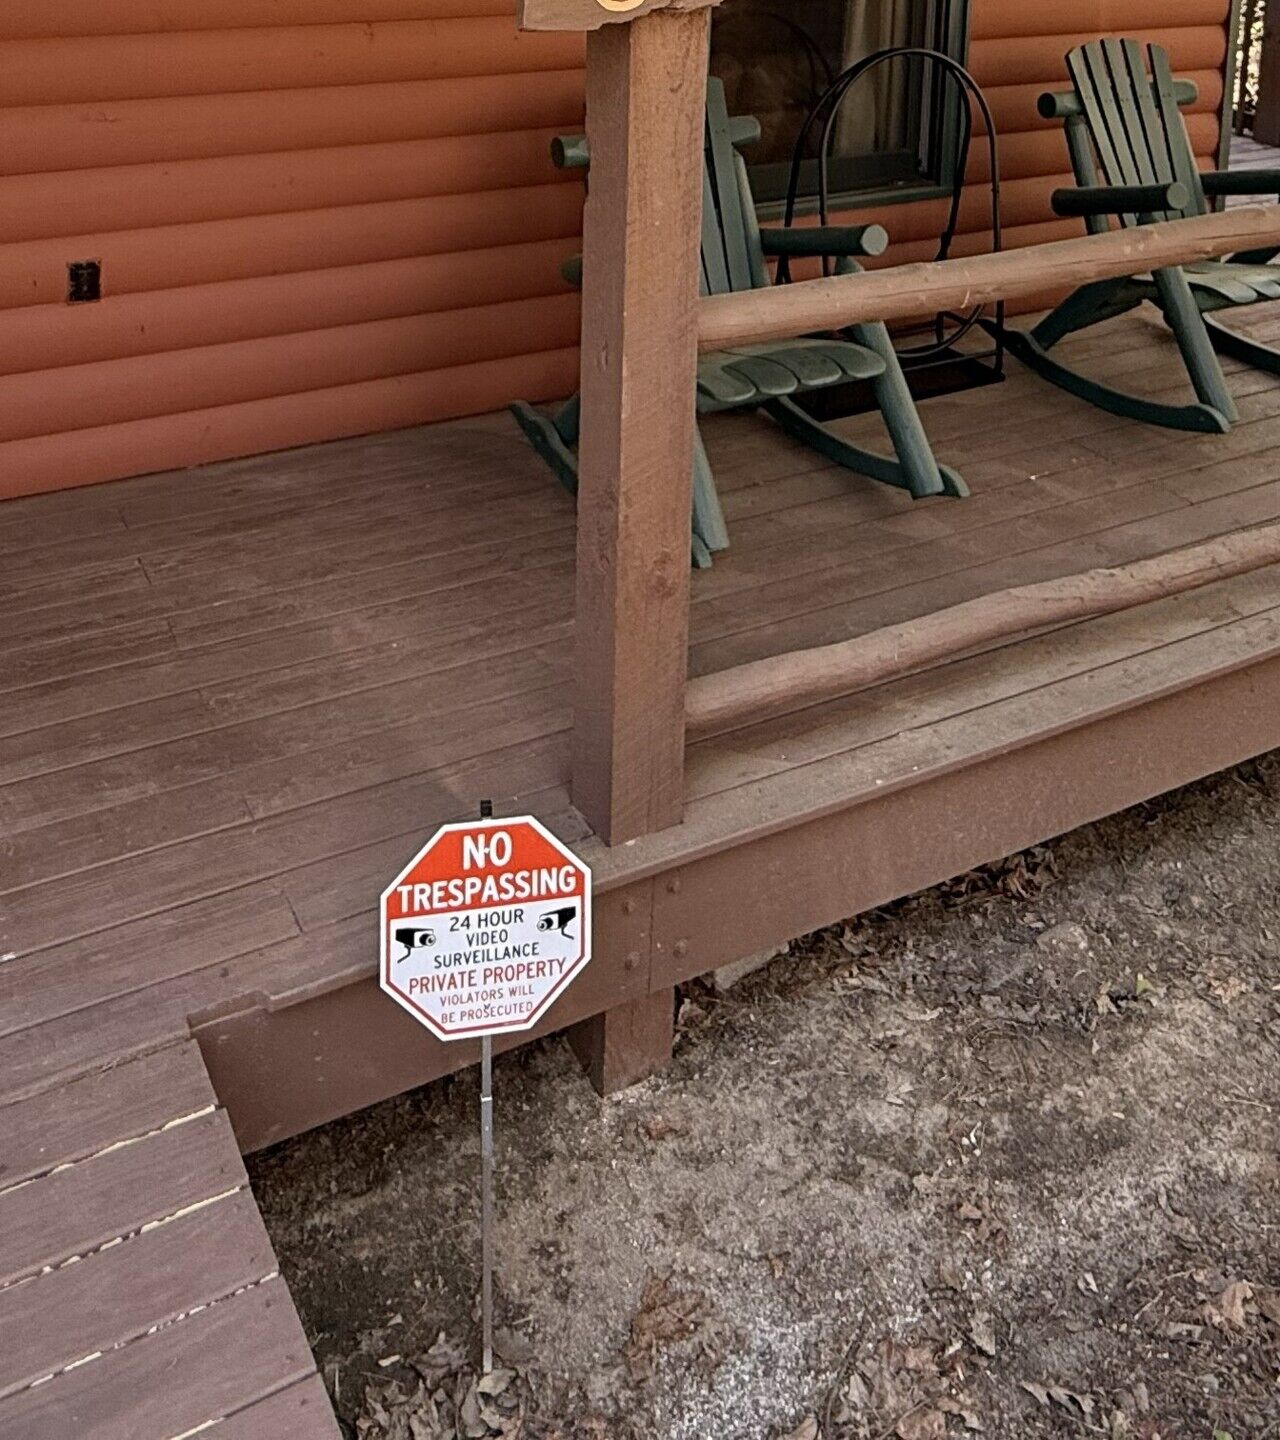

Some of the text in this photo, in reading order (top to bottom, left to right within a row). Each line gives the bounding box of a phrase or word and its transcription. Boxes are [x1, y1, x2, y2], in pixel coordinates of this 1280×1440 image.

[462, 831, 512, 870] NO
[397, 865, 576, 913] TRESPASSING
[449, 909, 524, 932] 24 HOUR
[466, 929, 508, 947] VIDEO
[434, 942, 540, 969] SURVEILLANCE
[409, 957, 566, 995] PRIVATE PROPERTY
[440, 984, 535, 1007] VIOLATORS WILL
[441, 1001, 533, 1024] BE PROSECUTED
